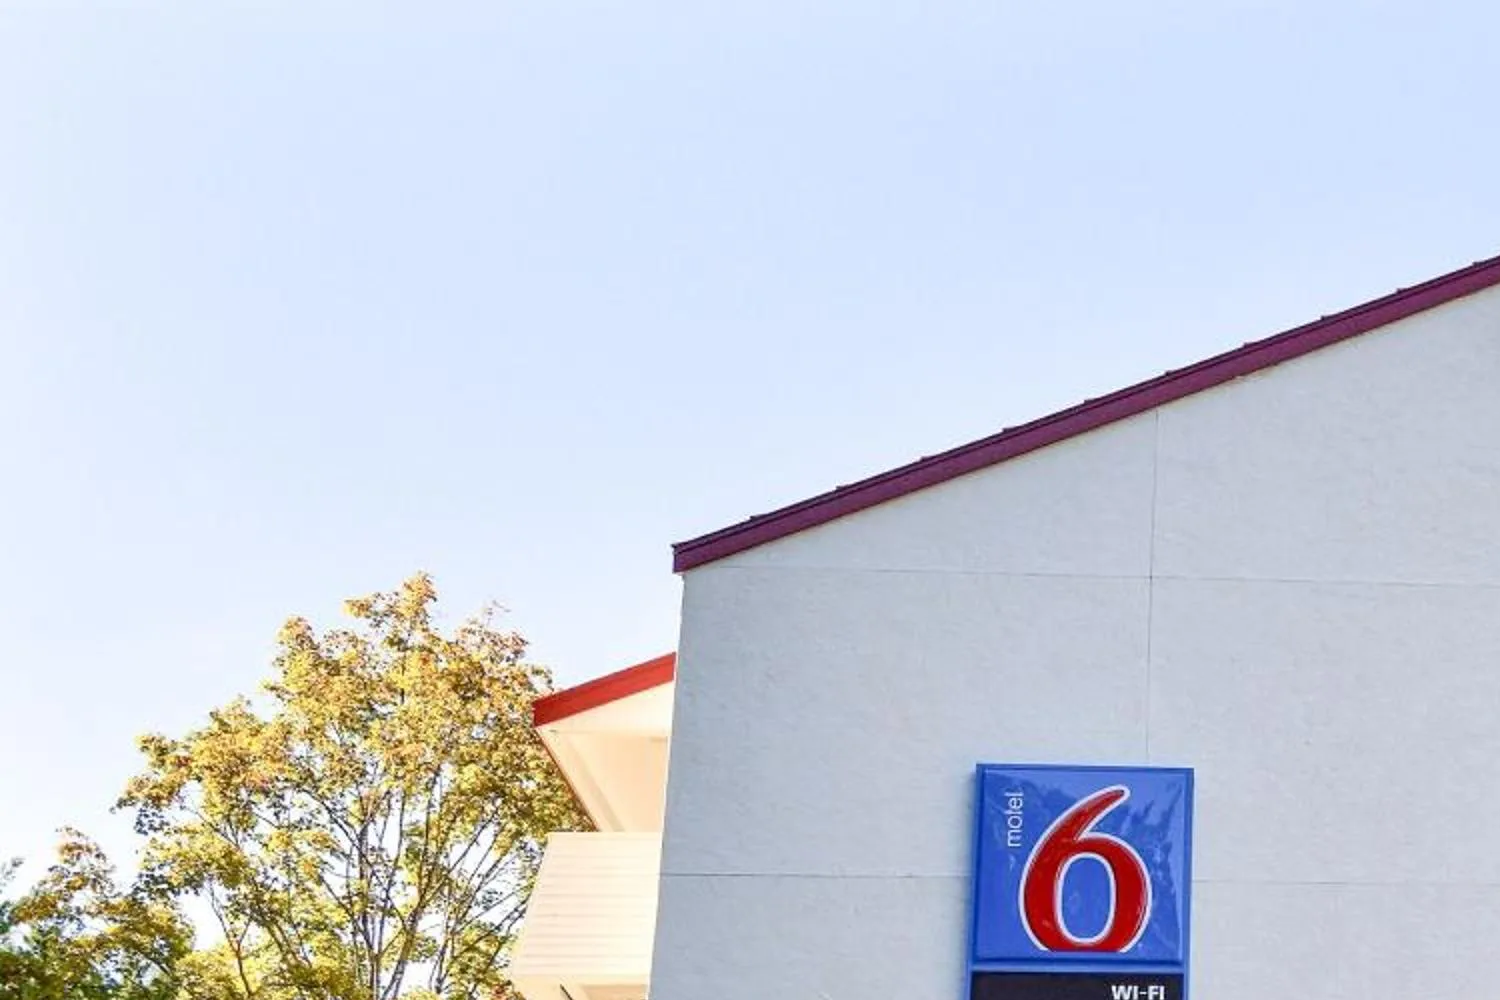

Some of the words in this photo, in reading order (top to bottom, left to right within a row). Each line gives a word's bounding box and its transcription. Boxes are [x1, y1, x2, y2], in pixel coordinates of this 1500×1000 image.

[1004, 790, 1024, 848] motel
[1018, 784, 1152, 953] 6
[1110, 984, 1165, 1000] WI-FI
